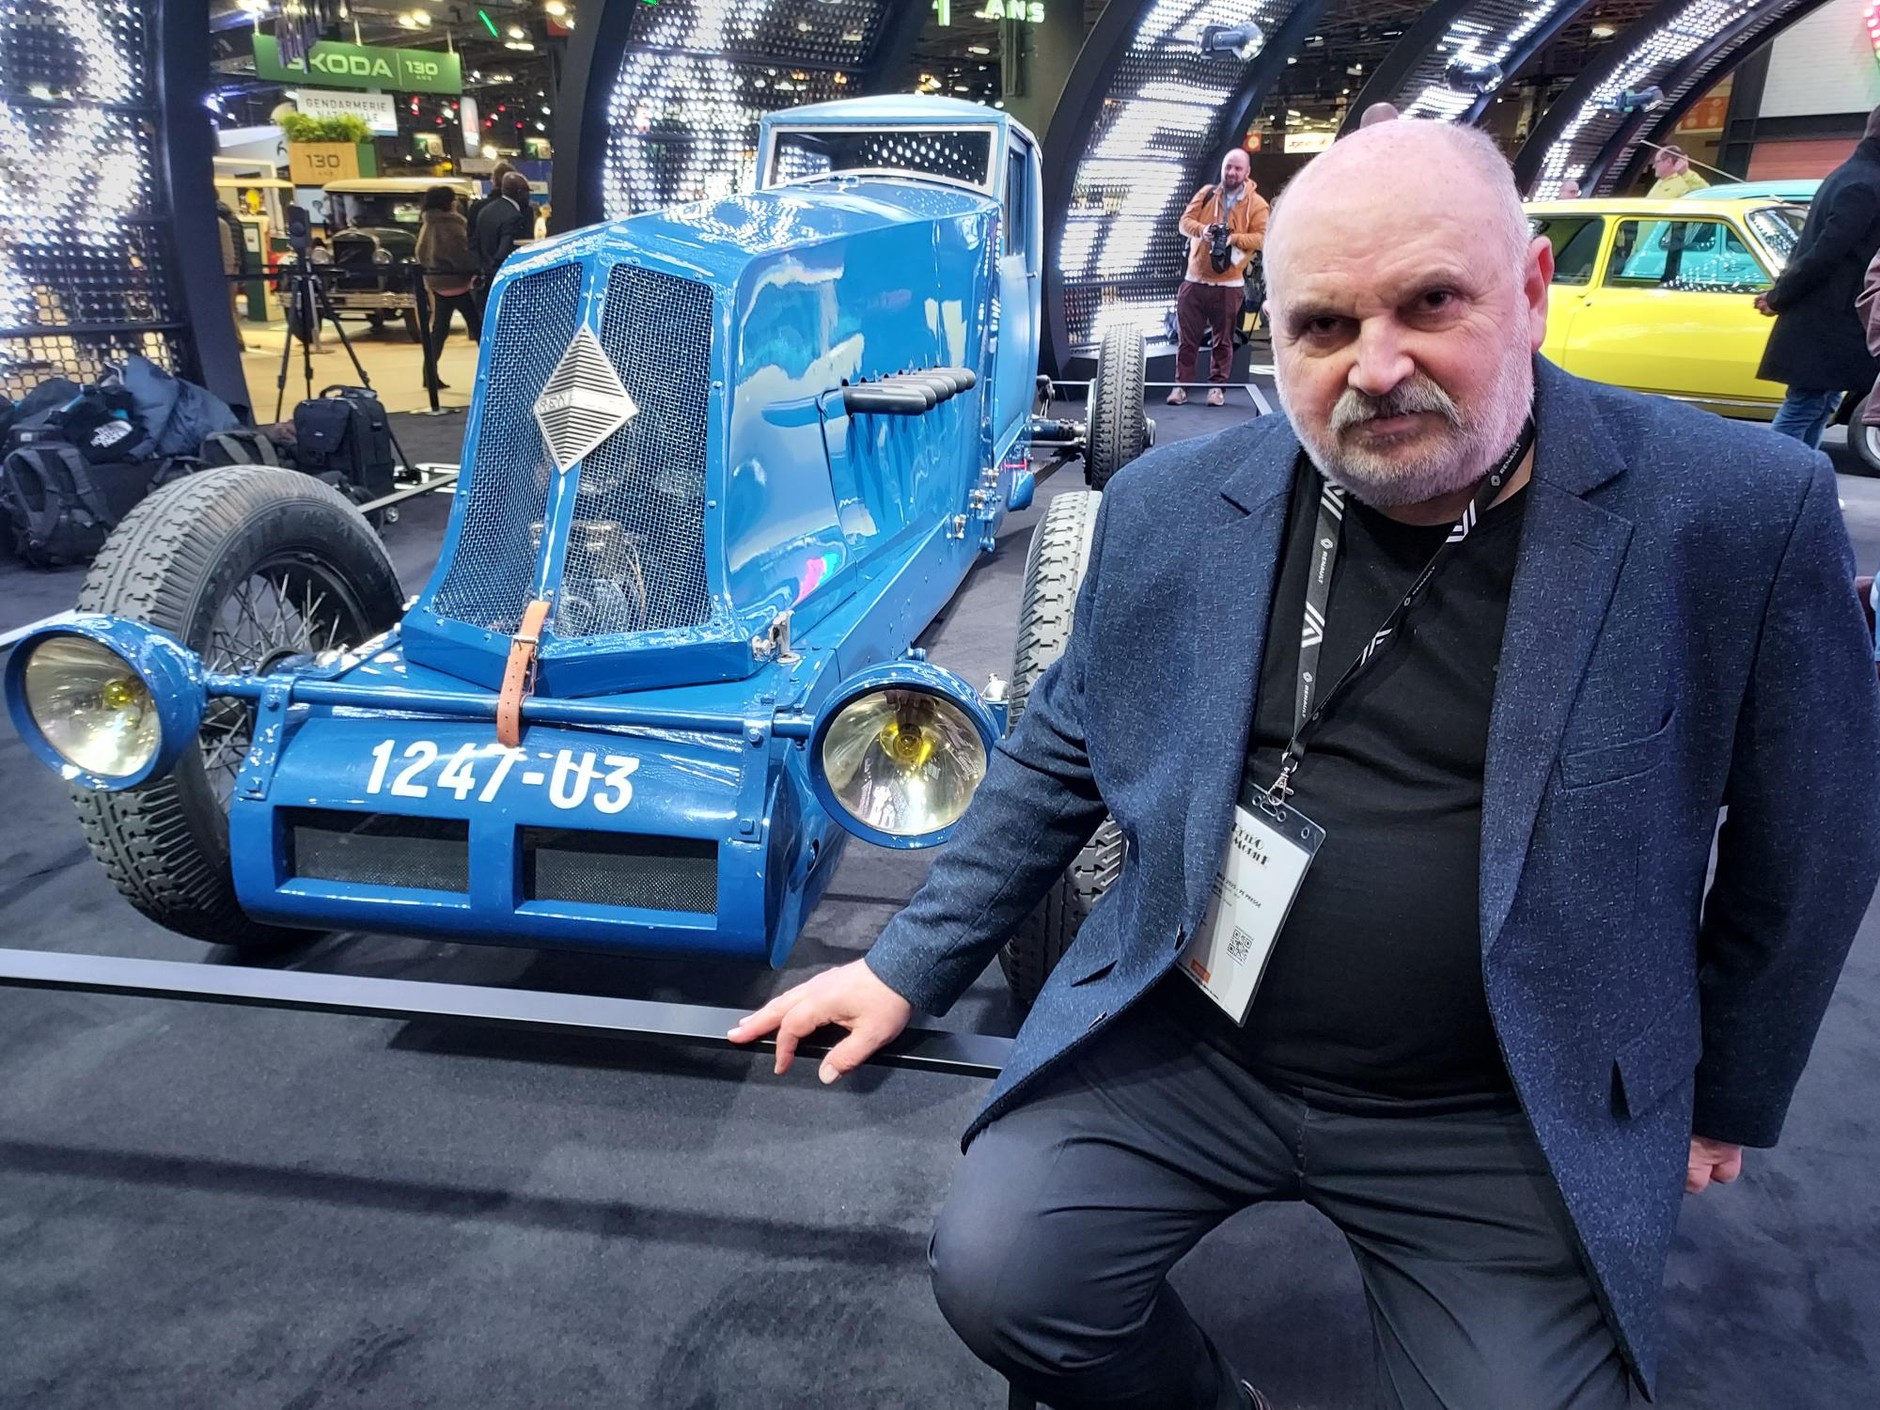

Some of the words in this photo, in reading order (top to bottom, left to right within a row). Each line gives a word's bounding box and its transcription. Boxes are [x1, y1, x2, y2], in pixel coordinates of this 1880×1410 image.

[405, 60, 439, 76] 130
[305, 97, 387, 112] GENDARMERIE
[305, 154, 341, 169] 130
[1499, 442, 1521, 474] RENAULT
[1318, 550, 1328, 585] RENAULT
